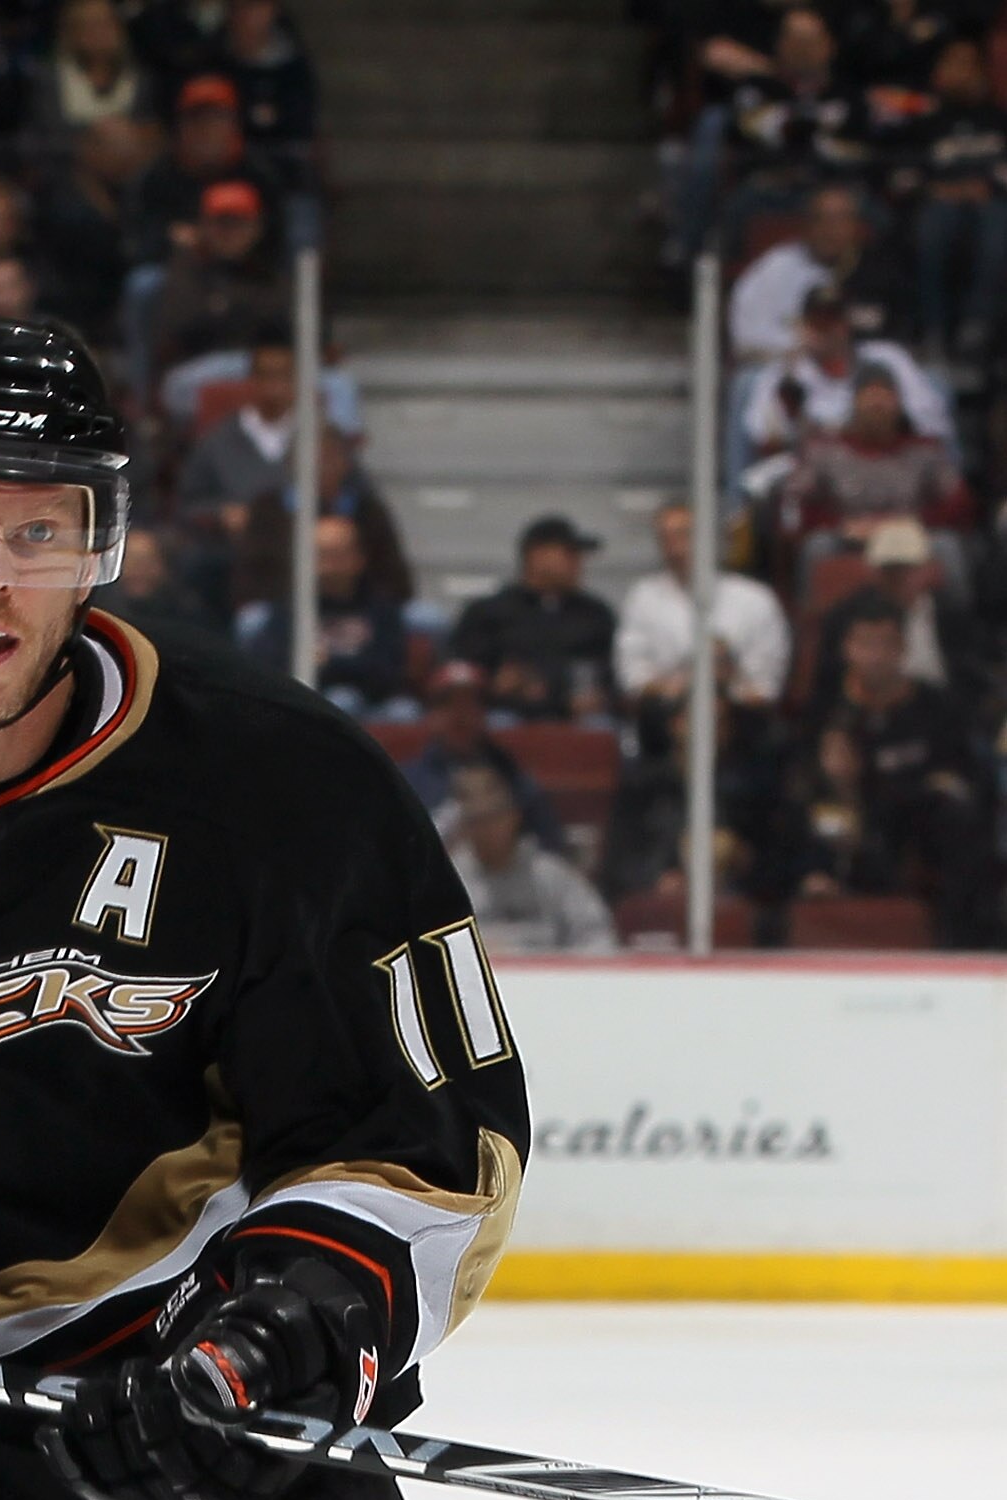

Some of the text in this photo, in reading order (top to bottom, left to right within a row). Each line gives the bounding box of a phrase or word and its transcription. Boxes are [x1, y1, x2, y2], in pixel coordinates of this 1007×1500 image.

[73, 822, 168, 946] A
[374, 915, 513, 1091] 11
[533, 1100, 833, 1160] calories
[156, 1271, 196, 1333] CCM
